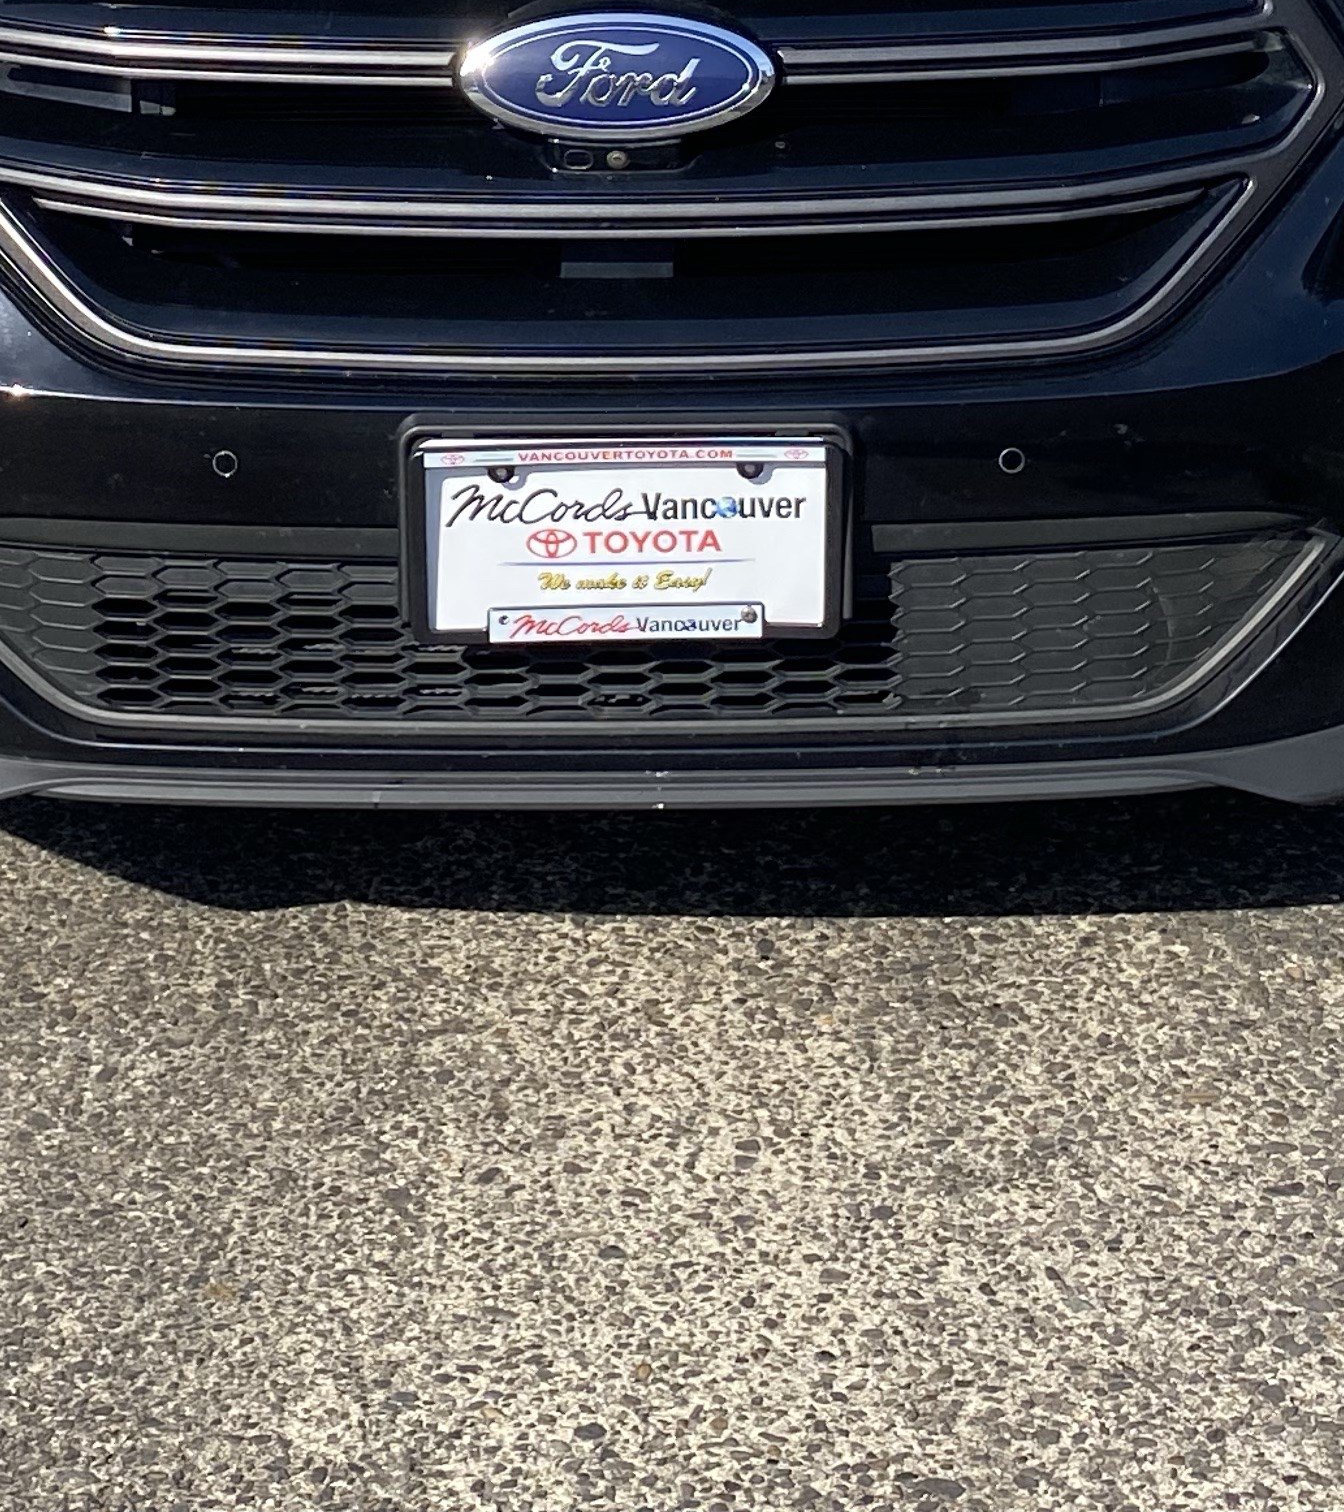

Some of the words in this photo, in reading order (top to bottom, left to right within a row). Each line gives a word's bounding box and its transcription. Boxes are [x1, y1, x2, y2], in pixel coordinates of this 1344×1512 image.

[534, 40, 701, 107] Ford
[517, 449, 734, 464] VANCOUVERTOYOTA.COM
[445, 484, 643, 528] McCords
[583, 529, 722, 555] TOYOTA
[538, 571, 571, 590] We
[576, 571, 627, 590] make
[632, 573, 650, 589] it
[509, 614, 638, 639] McCords
